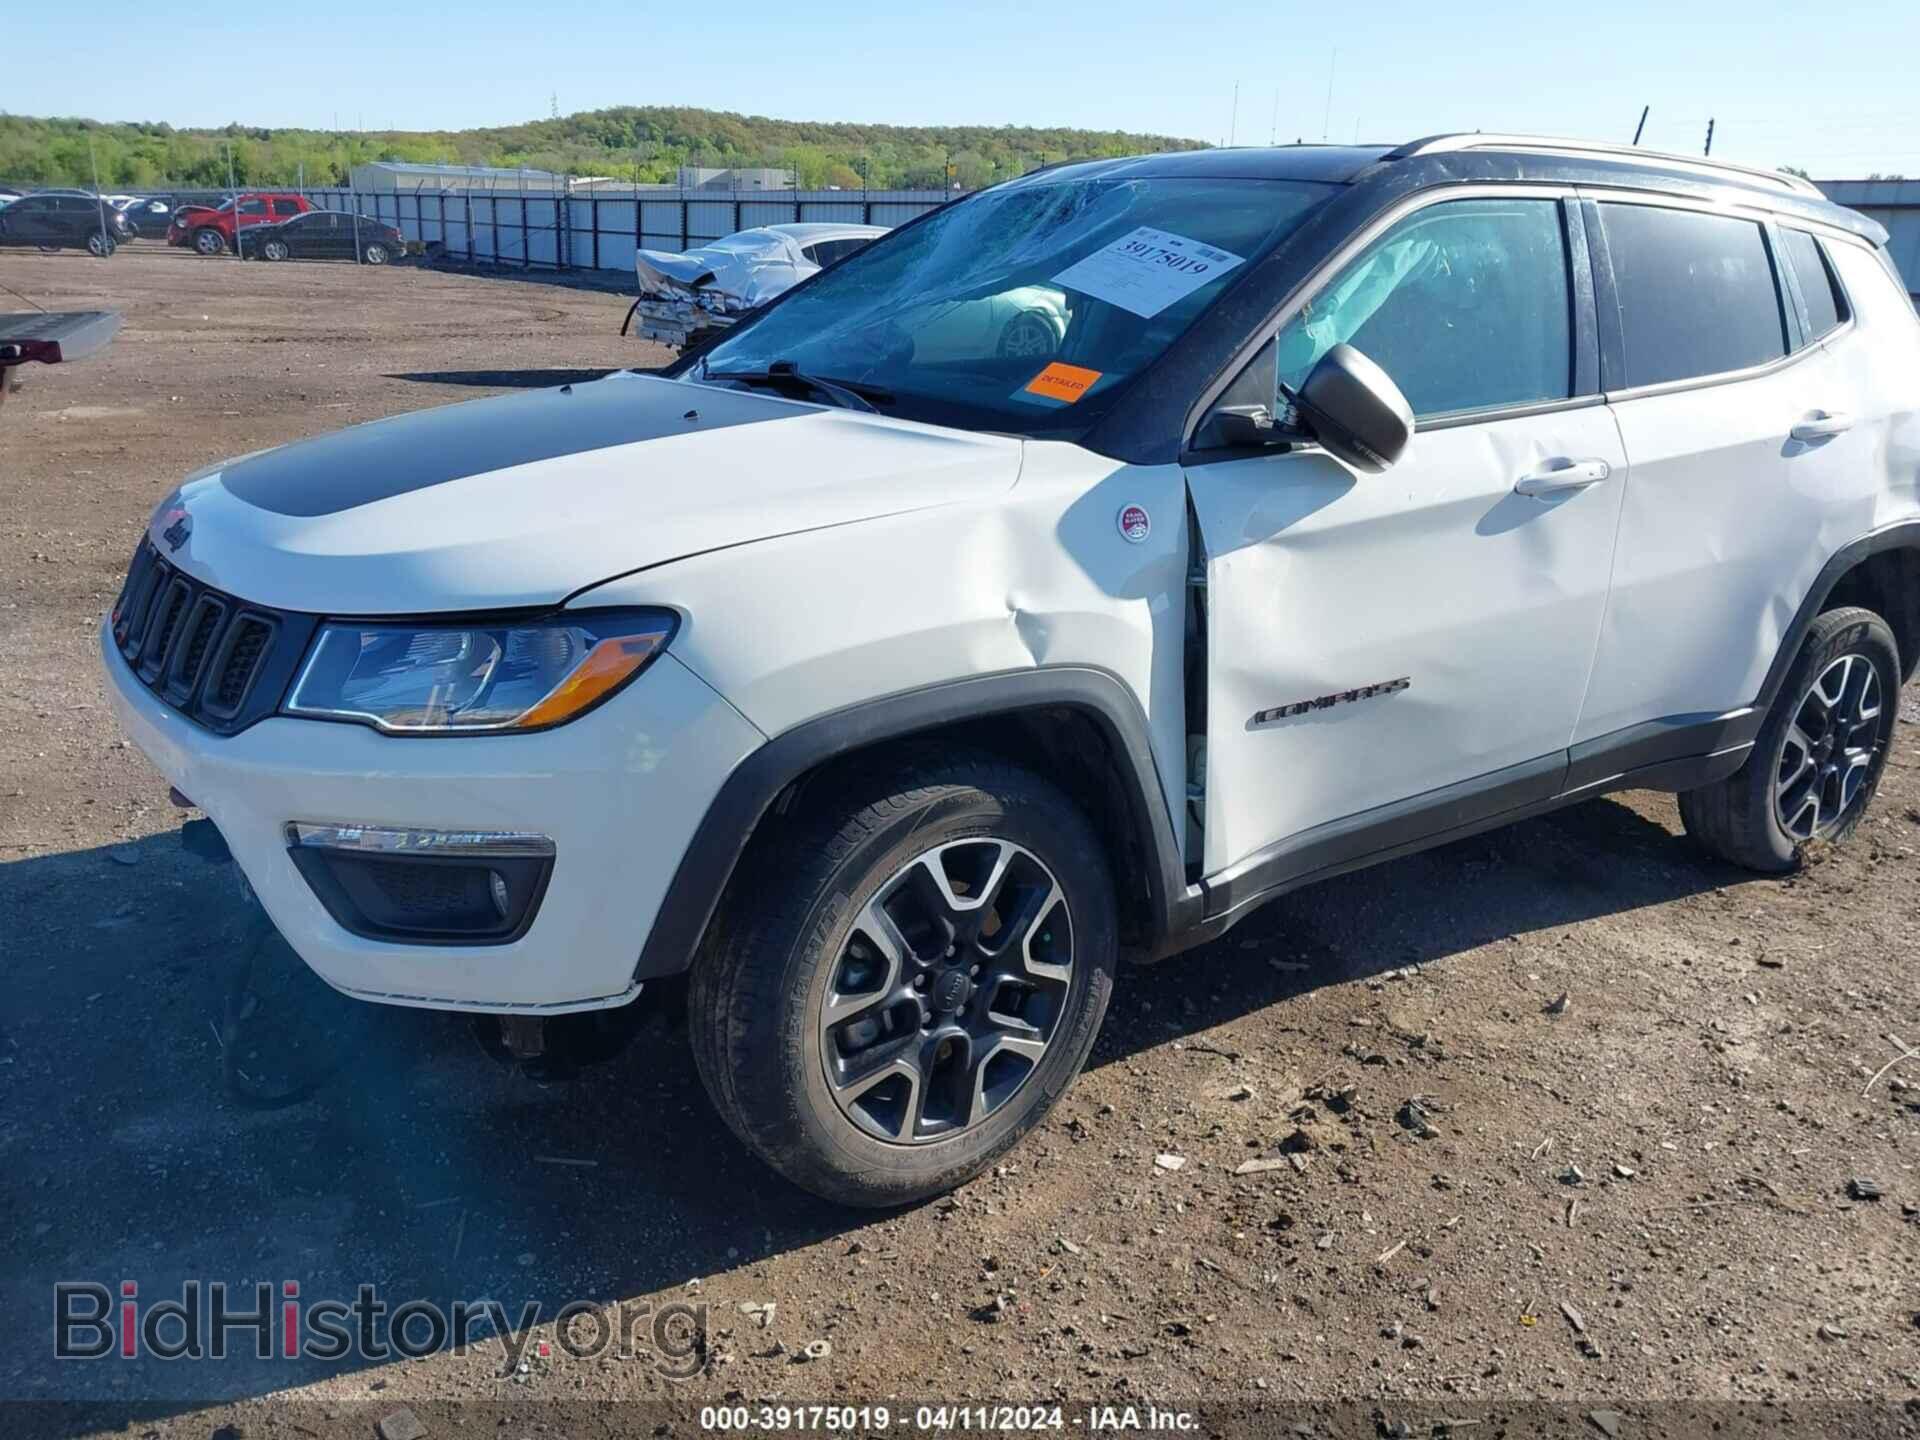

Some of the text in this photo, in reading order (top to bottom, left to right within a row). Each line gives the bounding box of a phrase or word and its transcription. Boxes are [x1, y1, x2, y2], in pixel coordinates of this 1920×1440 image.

[1116, 239, 1210, 275] 39175019
[1040, 375, 1084, 389] DETAILED
[1252, 677, 1411, 725] COMPASS
